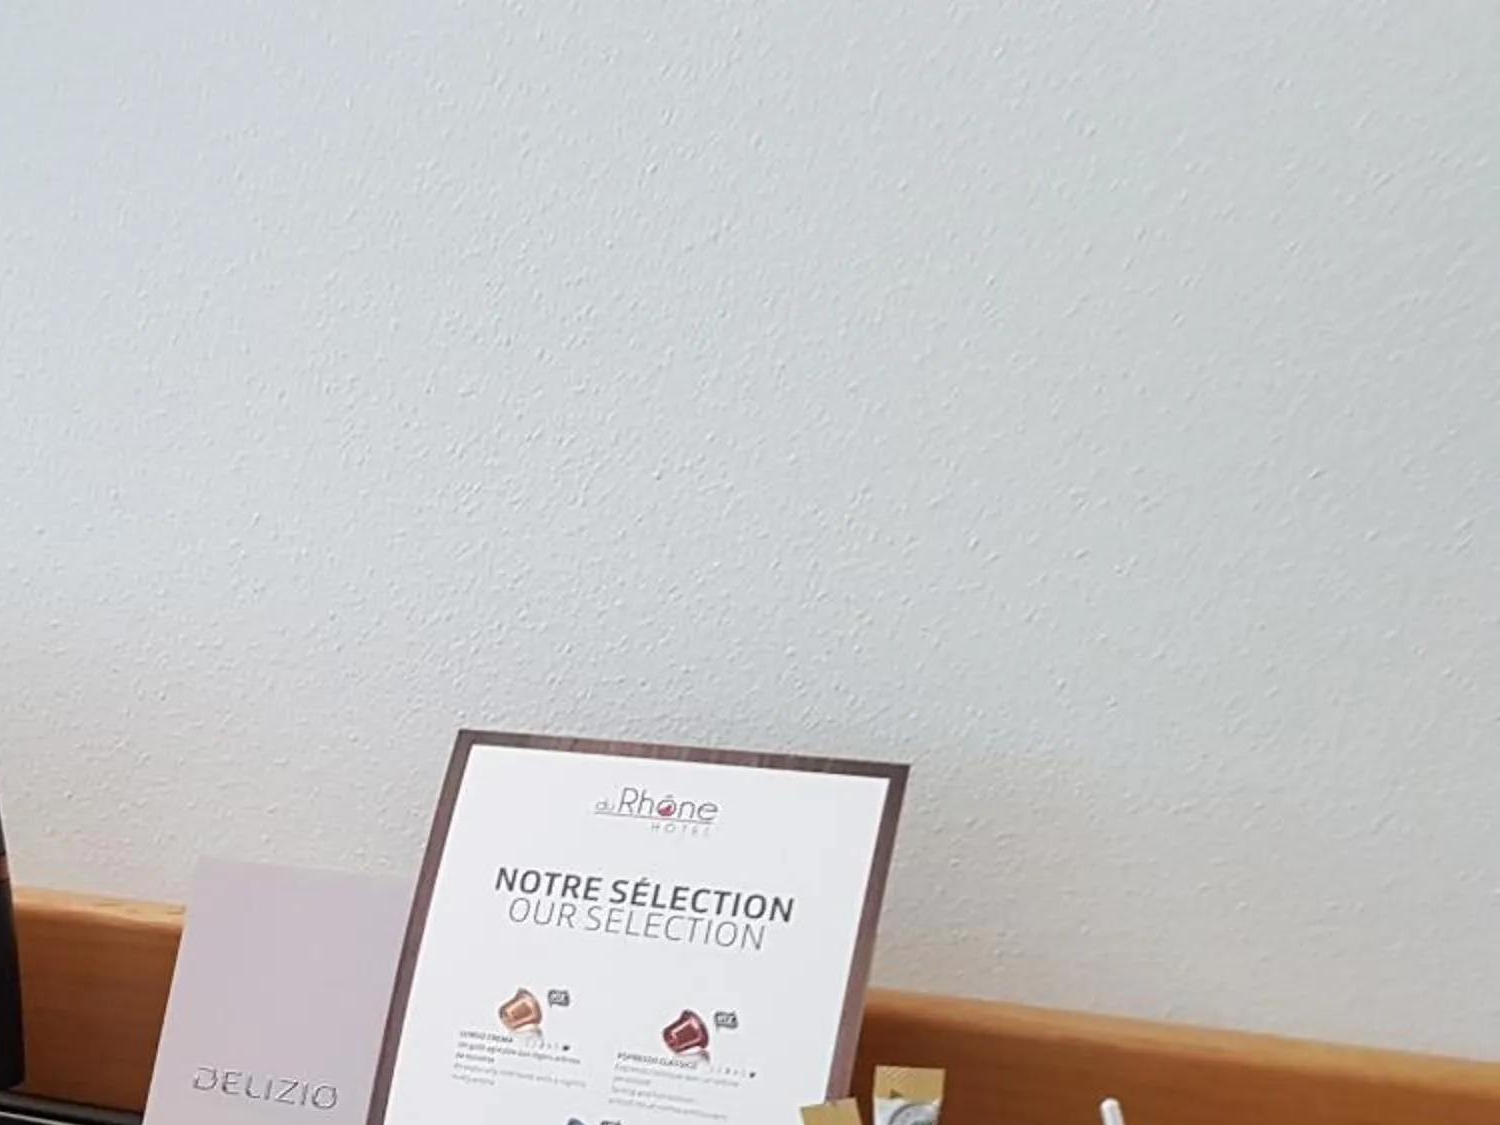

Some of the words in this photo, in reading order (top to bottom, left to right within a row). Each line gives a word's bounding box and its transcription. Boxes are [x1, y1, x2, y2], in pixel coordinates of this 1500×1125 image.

[618, 786, 720, 822] Rhône
[495, 866, 603, 901] NOTRE
[609, 877, 795, 923] SÉLECTION
[508, 897, 578, 929] OUR
[584, 905, 766, 950] SELECTION
[192, 1066, 339, 1110] DELIZIO
